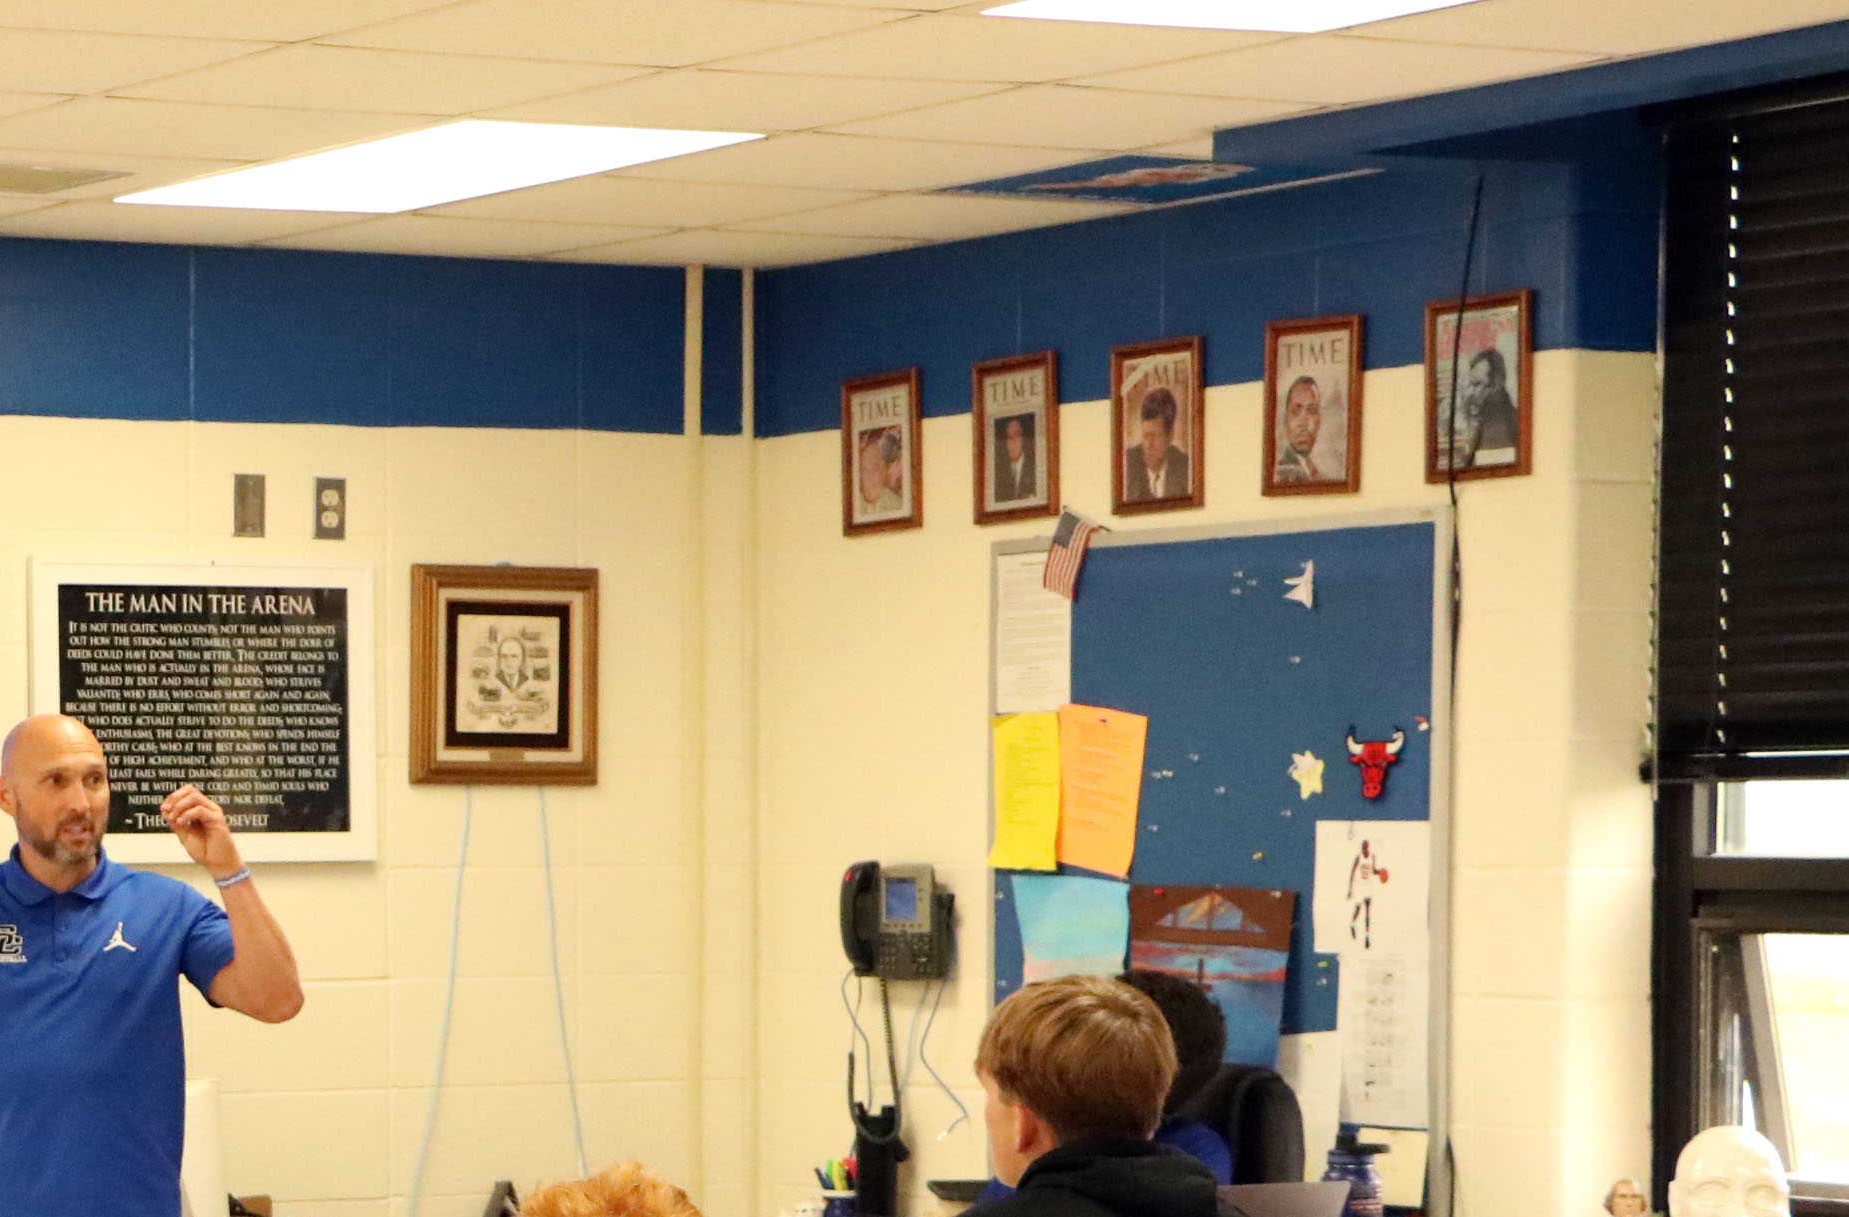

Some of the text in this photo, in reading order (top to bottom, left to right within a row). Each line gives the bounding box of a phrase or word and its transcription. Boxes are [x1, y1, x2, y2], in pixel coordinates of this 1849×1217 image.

[1284, 338, 1346, 369] TIME
[989, 375, 1040, 403] TIME
[858, 395, 903, 422] TIME
[85, 593, 315, 614] THE MAN IN THE ARENA
